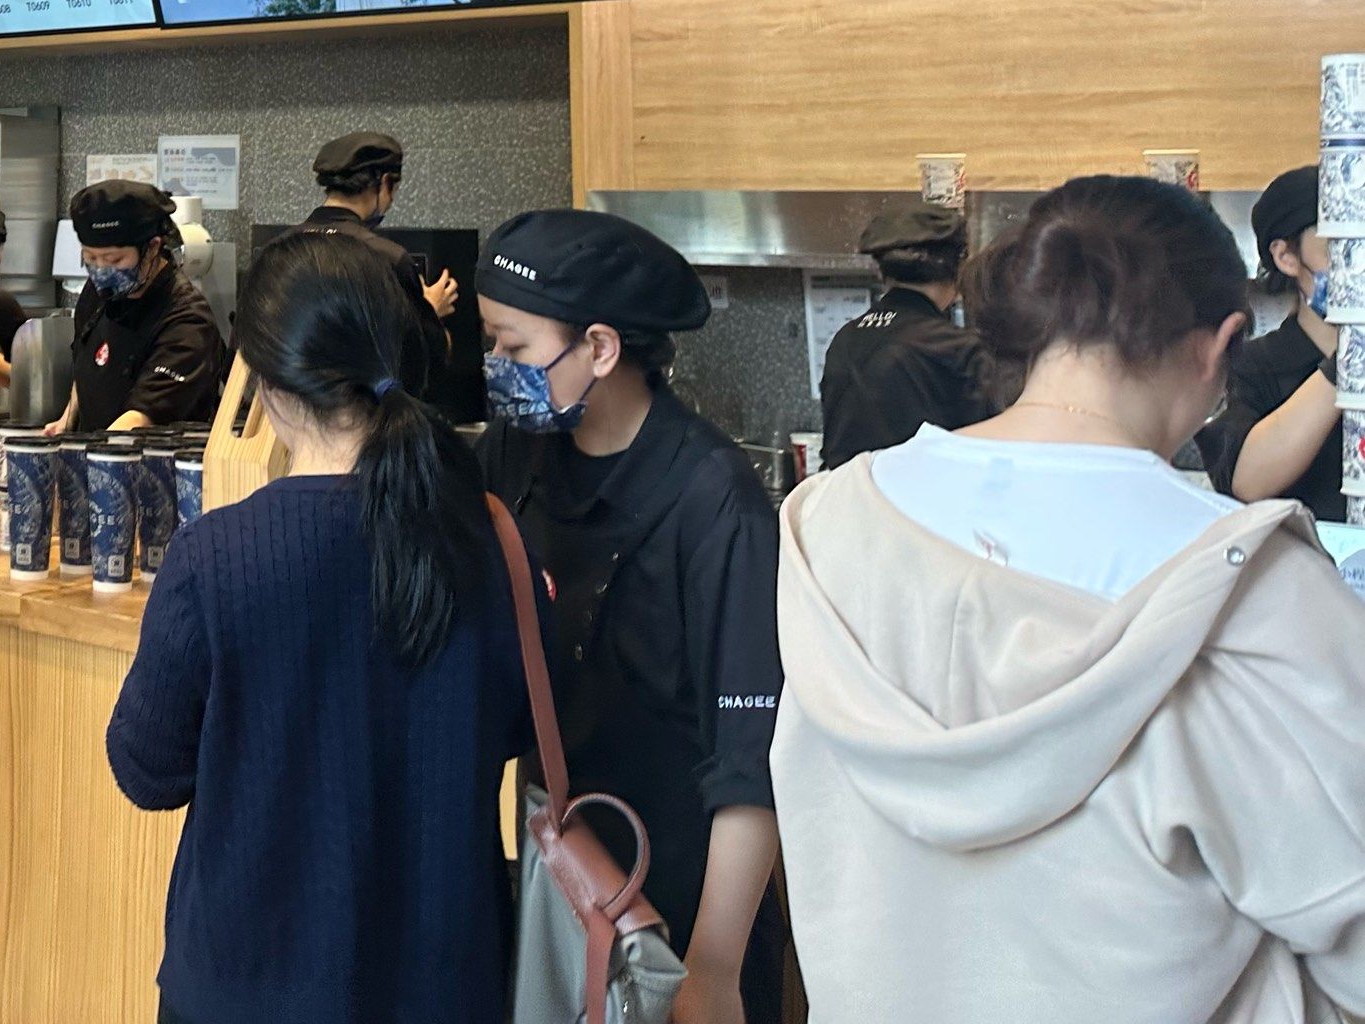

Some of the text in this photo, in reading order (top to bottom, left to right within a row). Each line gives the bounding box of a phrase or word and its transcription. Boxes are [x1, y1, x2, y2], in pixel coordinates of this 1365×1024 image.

[26, 0, 51, 12] T0609
[493, 254, 536, 281] CHAGEE
[718, 695, 776, 708] CHAGEE
